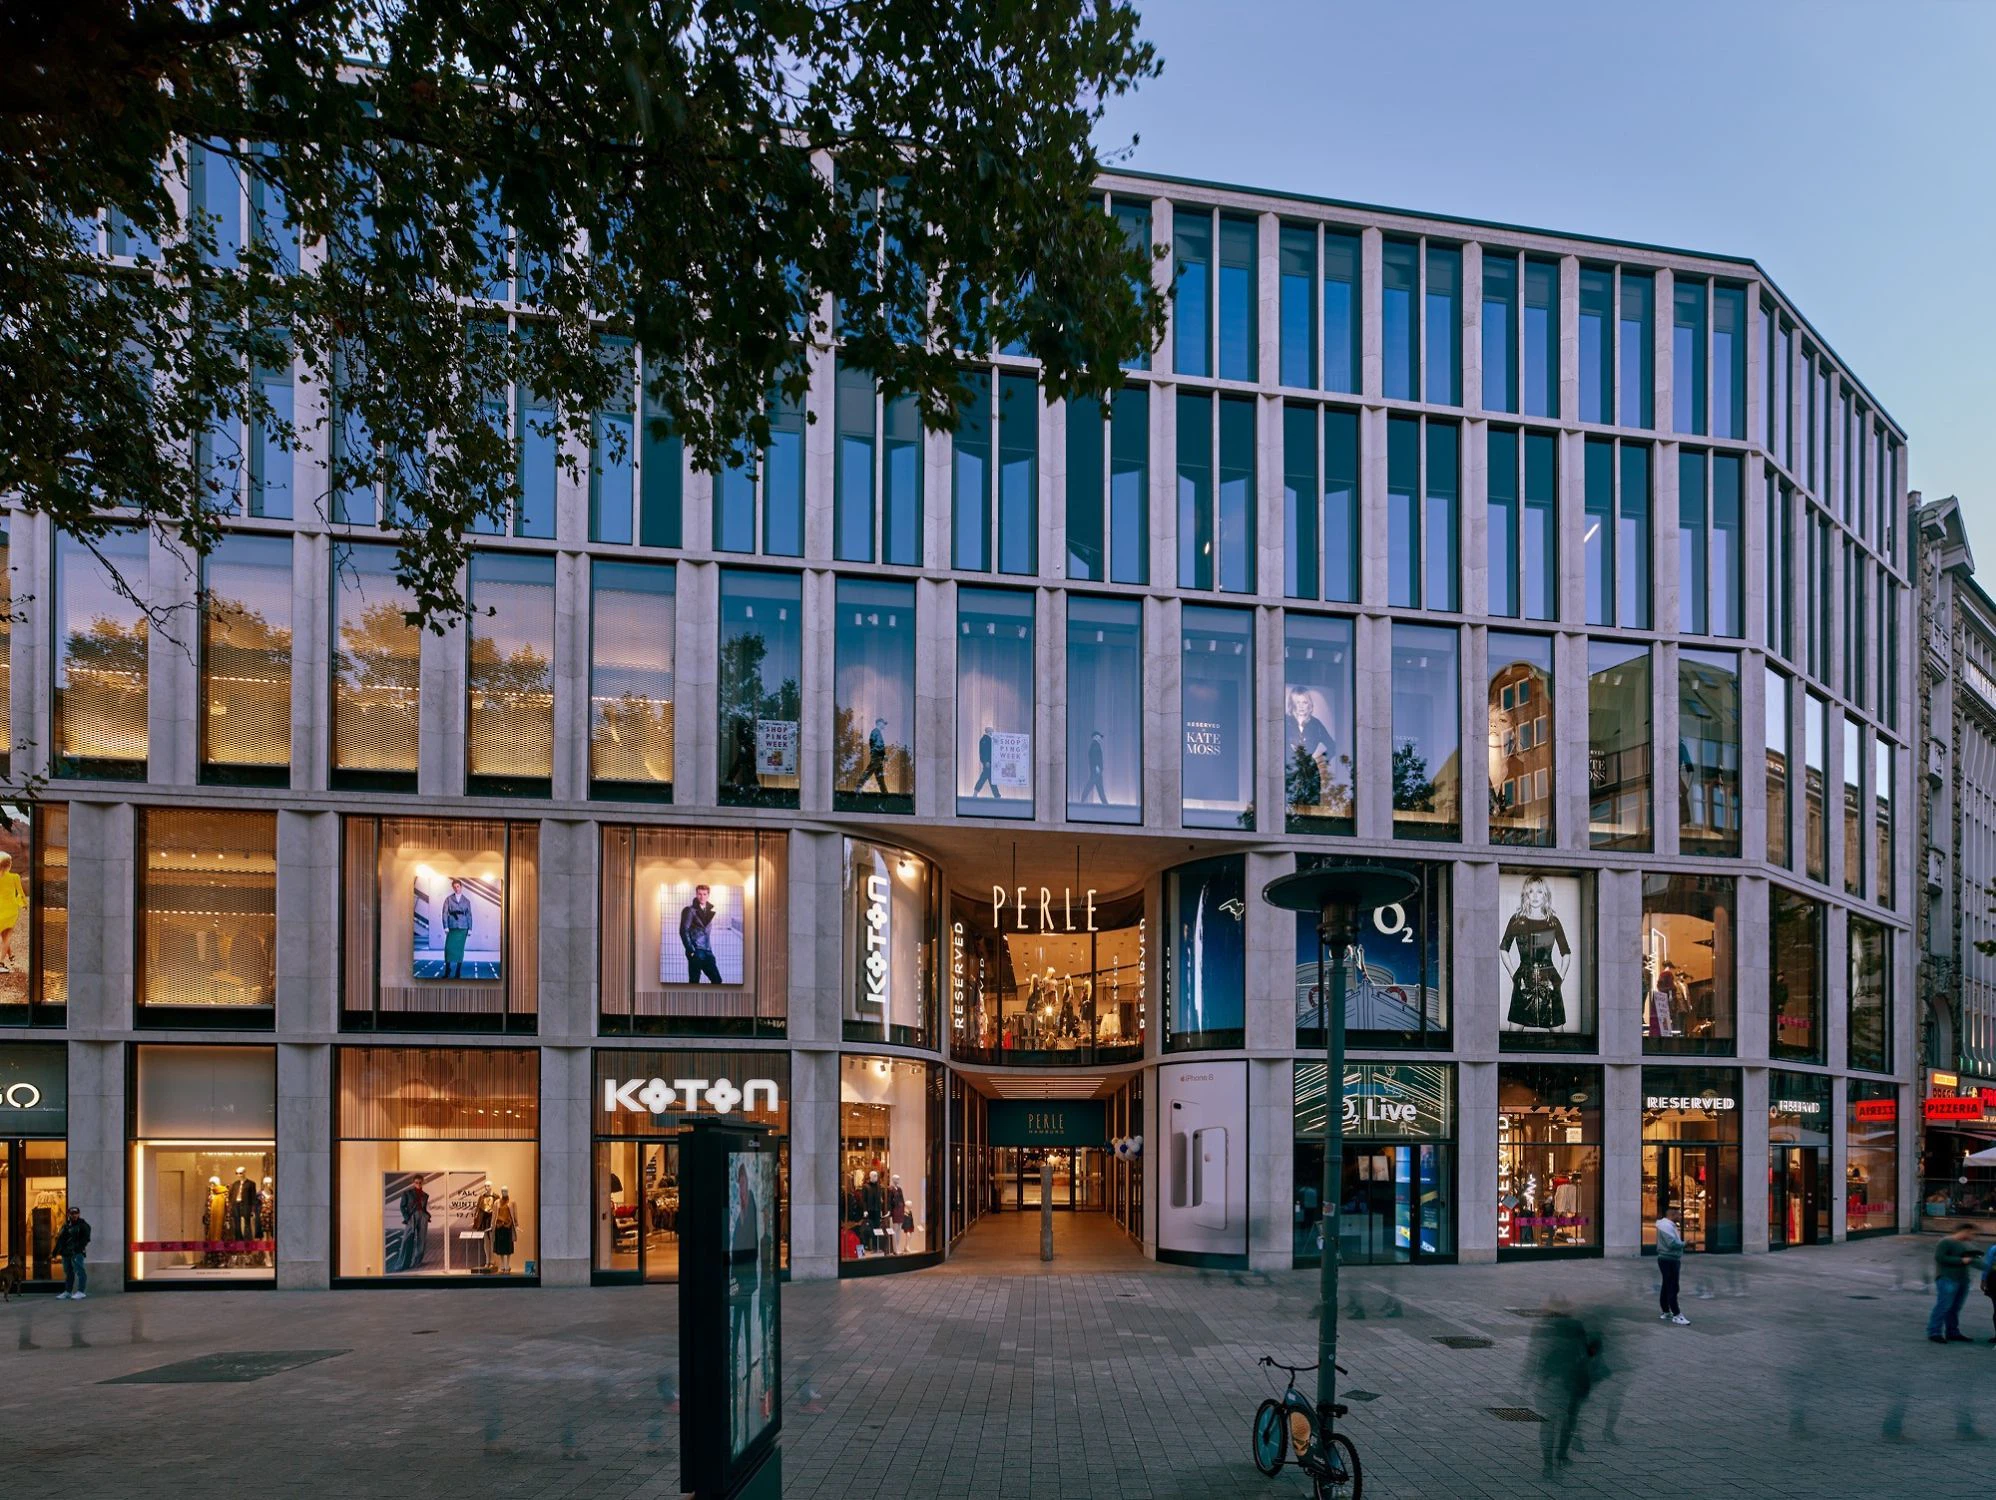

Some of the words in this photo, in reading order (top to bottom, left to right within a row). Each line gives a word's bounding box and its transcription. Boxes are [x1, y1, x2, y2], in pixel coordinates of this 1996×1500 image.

[1187, 732, 1221, 744] KATE
[1187, 743, 1221, 755] MOSS
[993, 885, 1099, 932] PERLE
[866, 874, 888, 1004] KOTON
[954, 921, 964, 1029] RESERVED
[604, 1077, 779, 1115] KOTON
[1646, 1096, 1735, 1110] RESERVED
[1366, 1097, 1417, 1121] Live
[1927, 1103, 1978, 1114] PIZZERIA
[1028, 1113, 1065, 1129] PERLE
